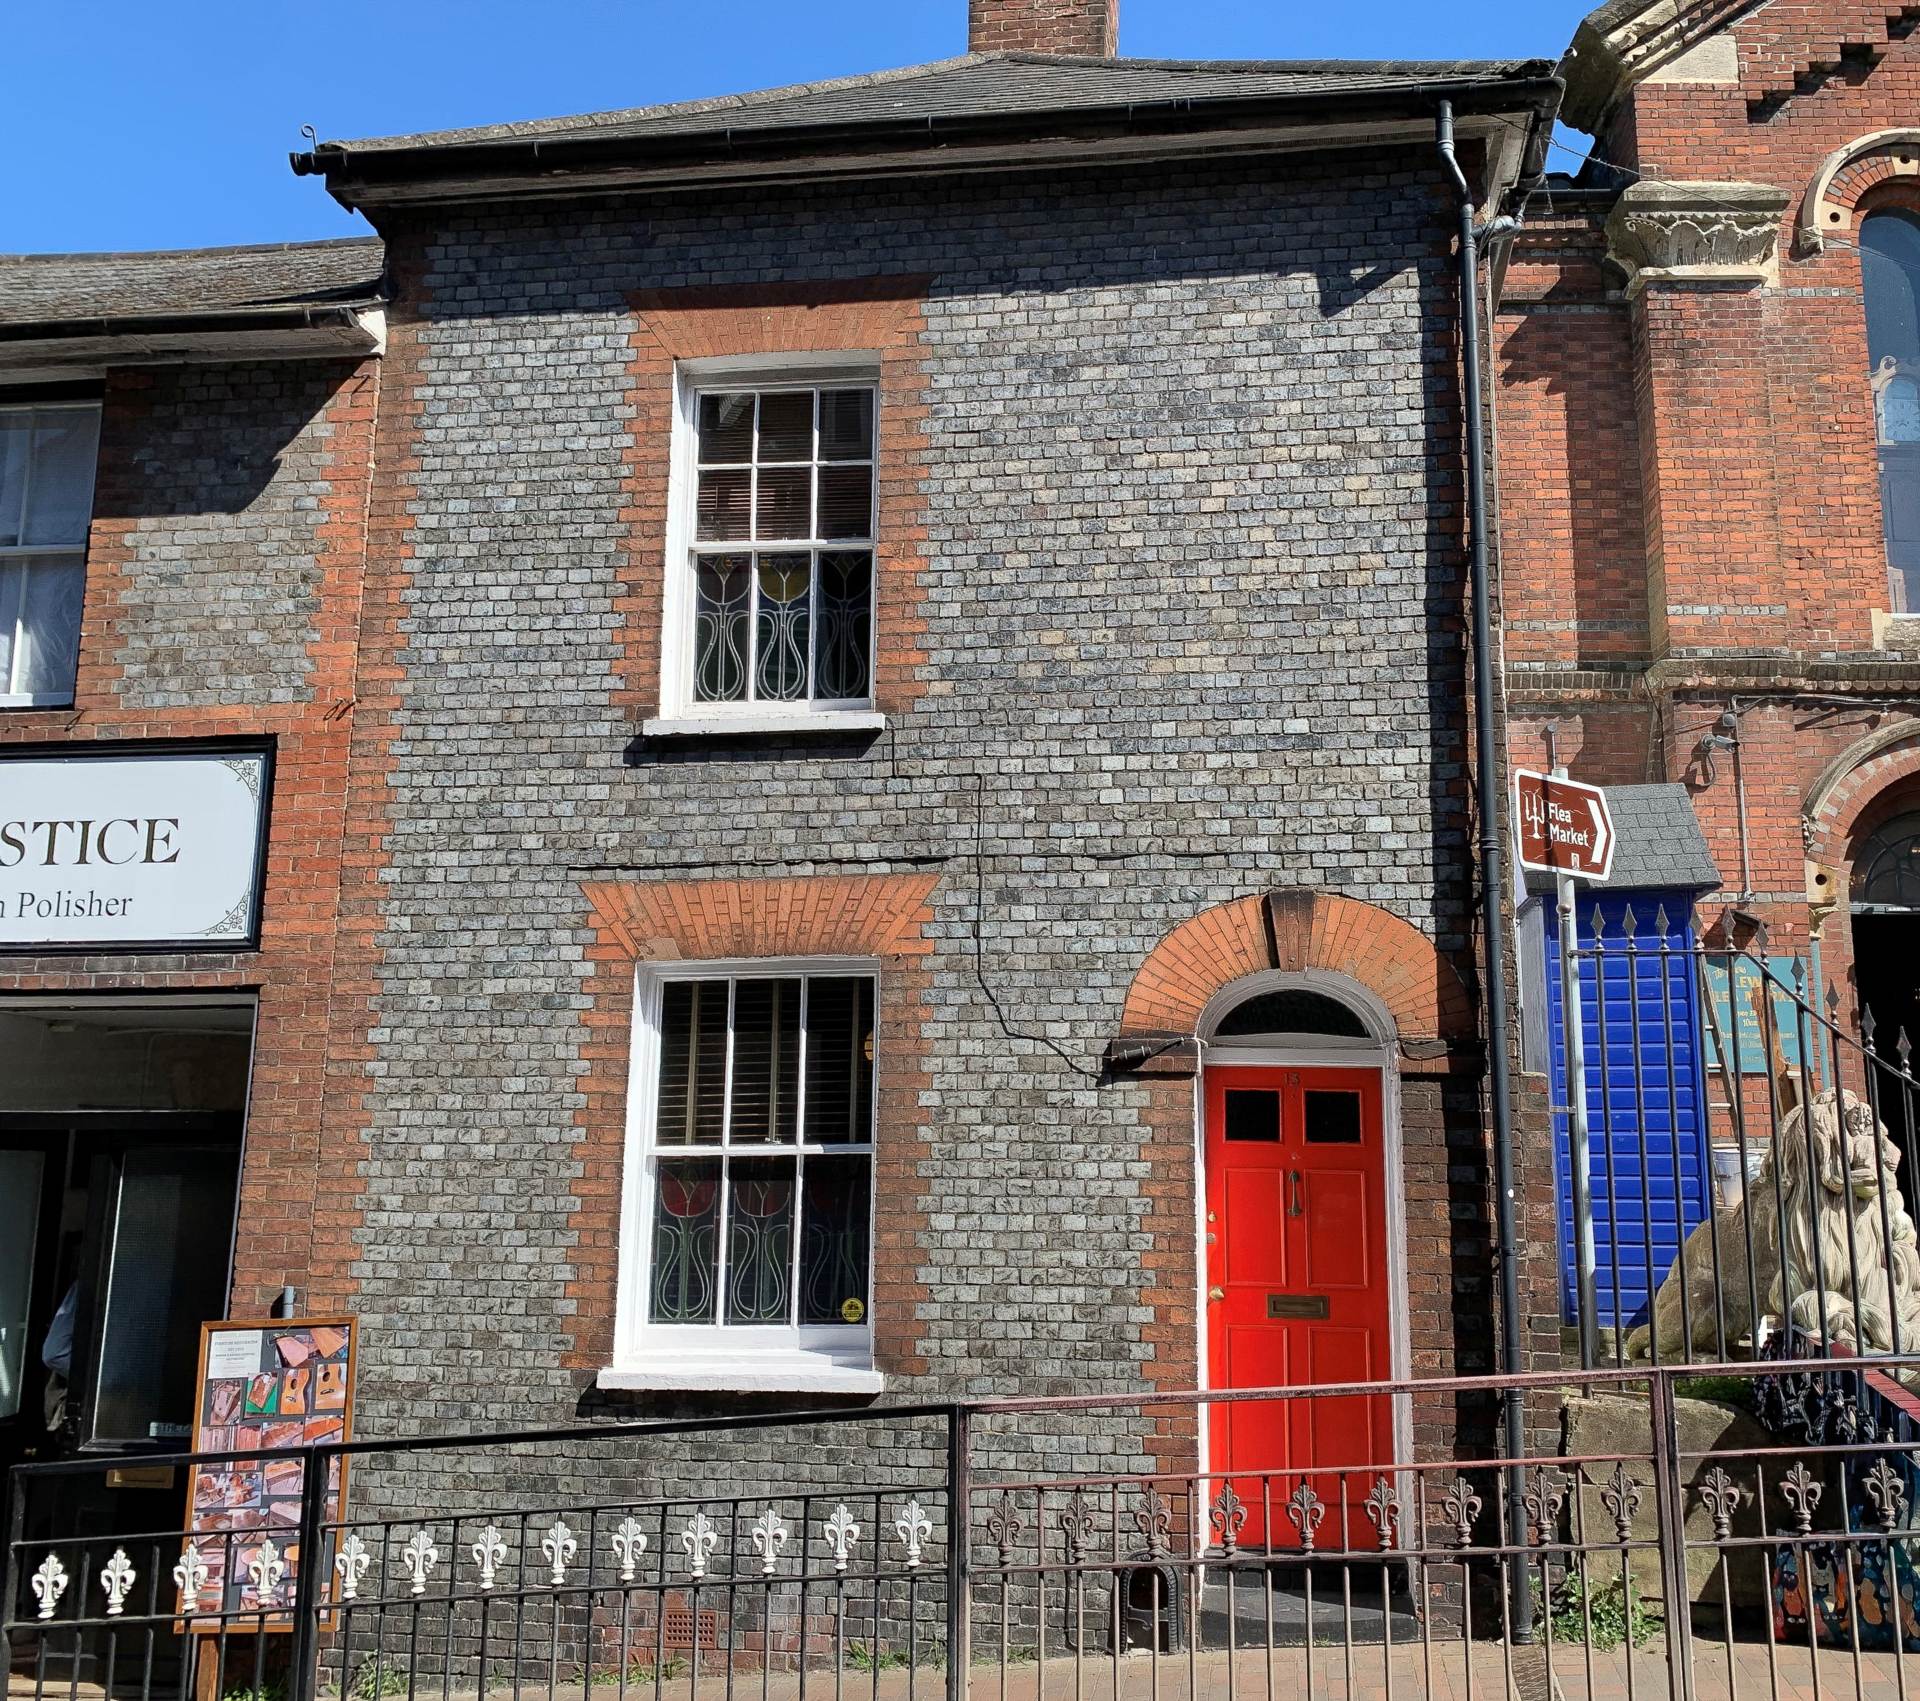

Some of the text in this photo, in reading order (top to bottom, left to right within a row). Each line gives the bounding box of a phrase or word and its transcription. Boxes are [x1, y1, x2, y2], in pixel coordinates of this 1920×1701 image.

[1548, 802, 1572, 823] Flea
[1549, 823, 1589, 846] Market
[16, 890, 133, 918] Polisher
